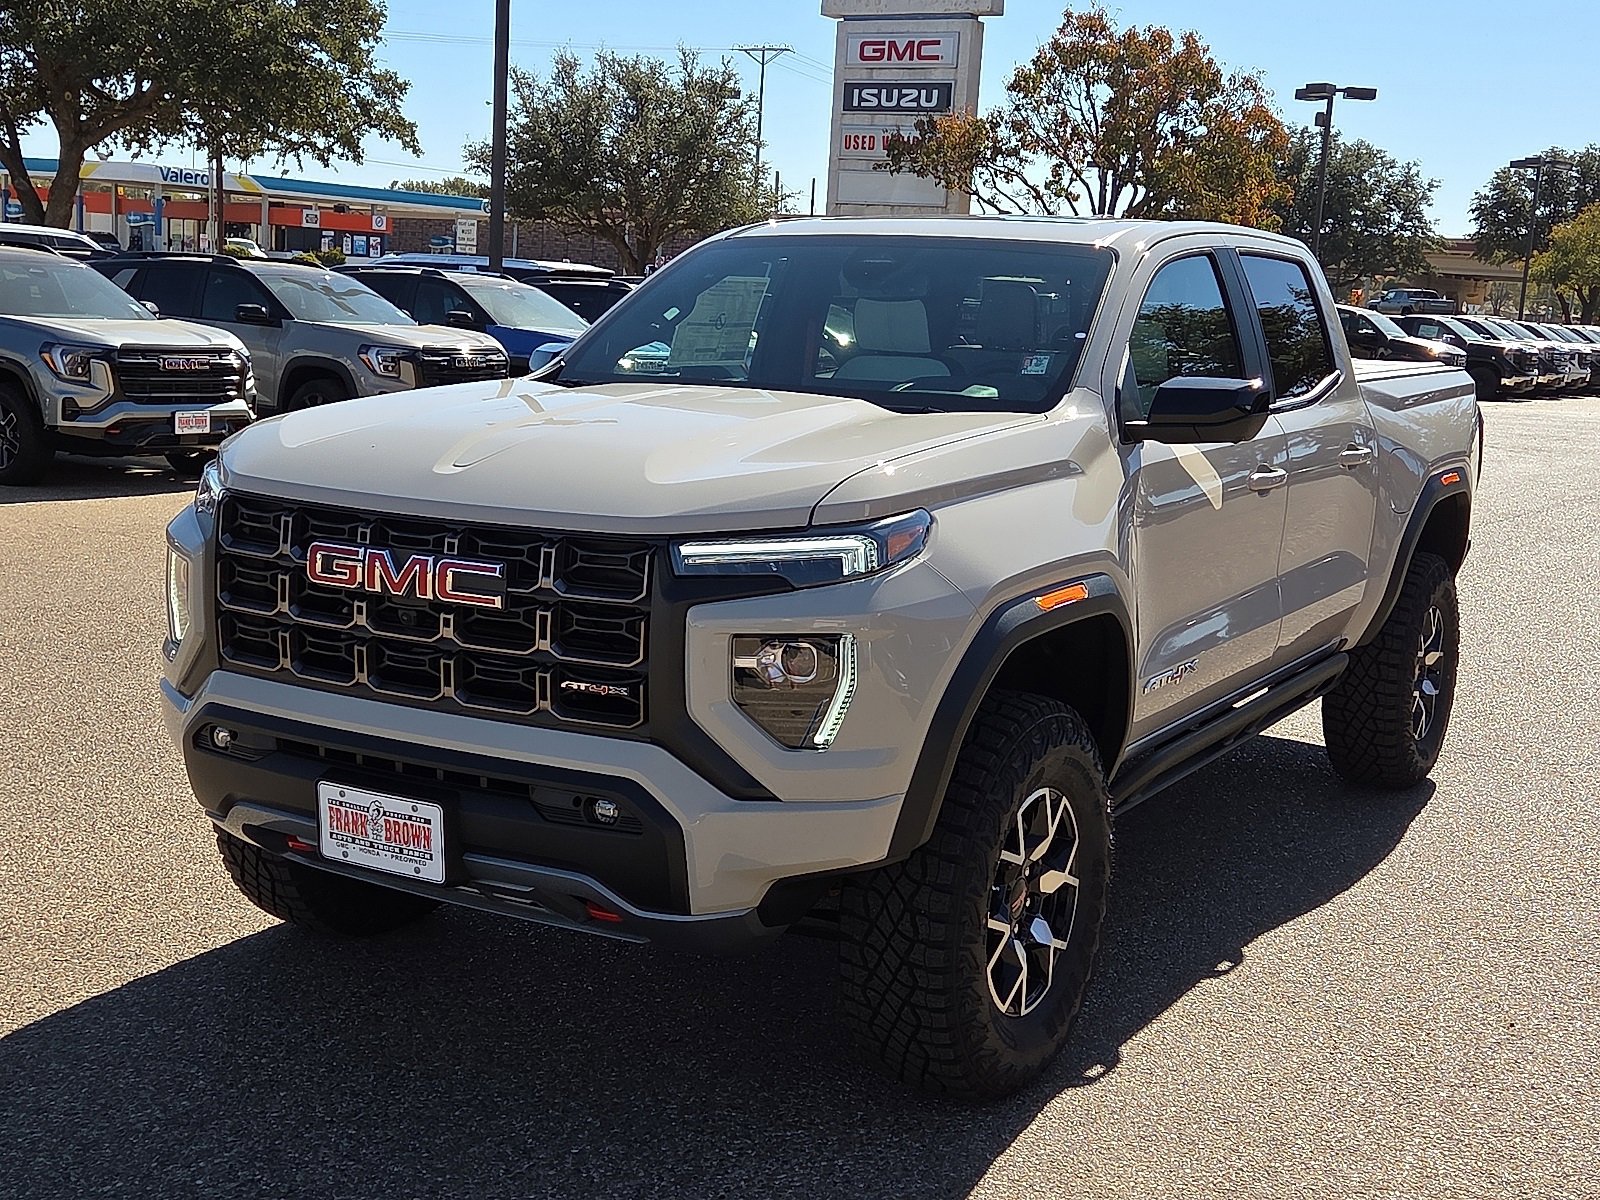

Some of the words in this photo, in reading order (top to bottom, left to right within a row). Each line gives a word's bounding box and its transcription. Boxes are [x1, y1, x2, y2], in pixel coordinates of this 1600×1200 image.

[859, 40, 941, 61] GMC
[852, 88, 939, 108] ISUZU
[844, 134, 876, 151] USED
[160, 166, 210, 186] Valero
[165, 359, 210, 370] GMC
[307, 541, 503, 610] GMC
[560, 681, 628, 696] AT4X
[328, 806, 369, 838] FRANK
[384, 818, 433, 852] BROWN
[332, 833, 353, 843] AUTO
[355, 838, 371, 847] AND
[373, 843, 400, 854] TRUCK
[402, 849, 431, 860] RANCH
[335, 842, 349, 850] GMC
[358, 846, 381, 857] HONDA
[390, 854, 427, 867] PREOWNED
